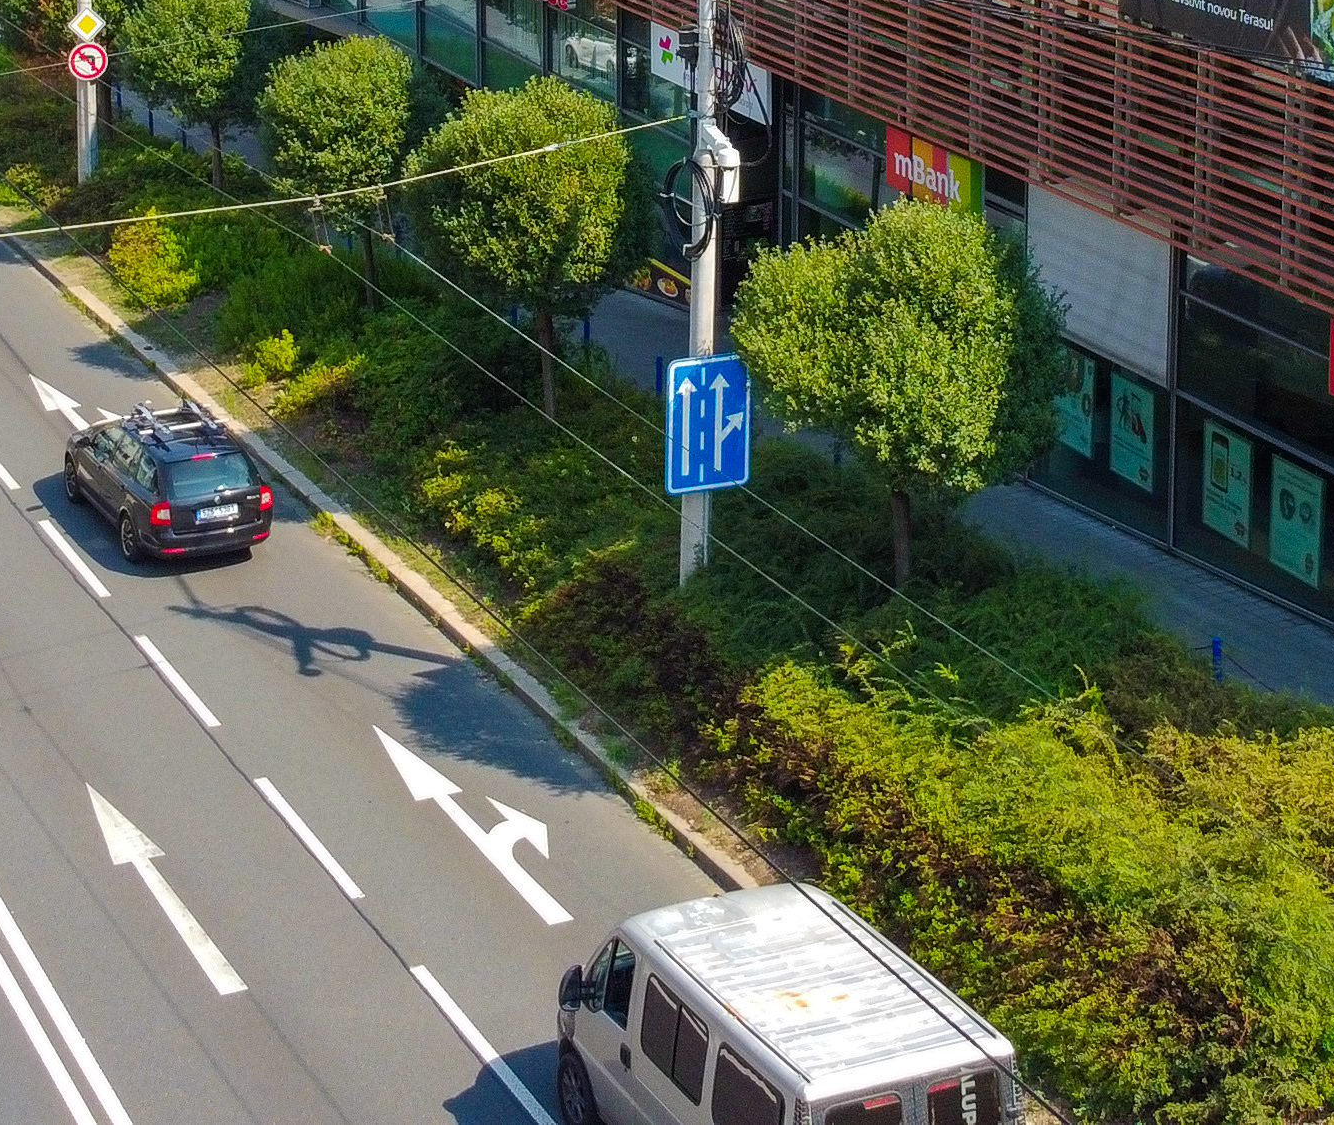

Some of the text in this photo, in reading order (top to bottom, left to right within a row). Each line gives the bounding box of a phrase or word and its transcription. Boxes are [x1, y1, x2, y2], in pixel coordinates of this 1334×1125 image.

[1207, 1, 1237, 20] novou
[1238, 9, 1274, 32] Terasu!
[894, 152, 962, 203] mBank
